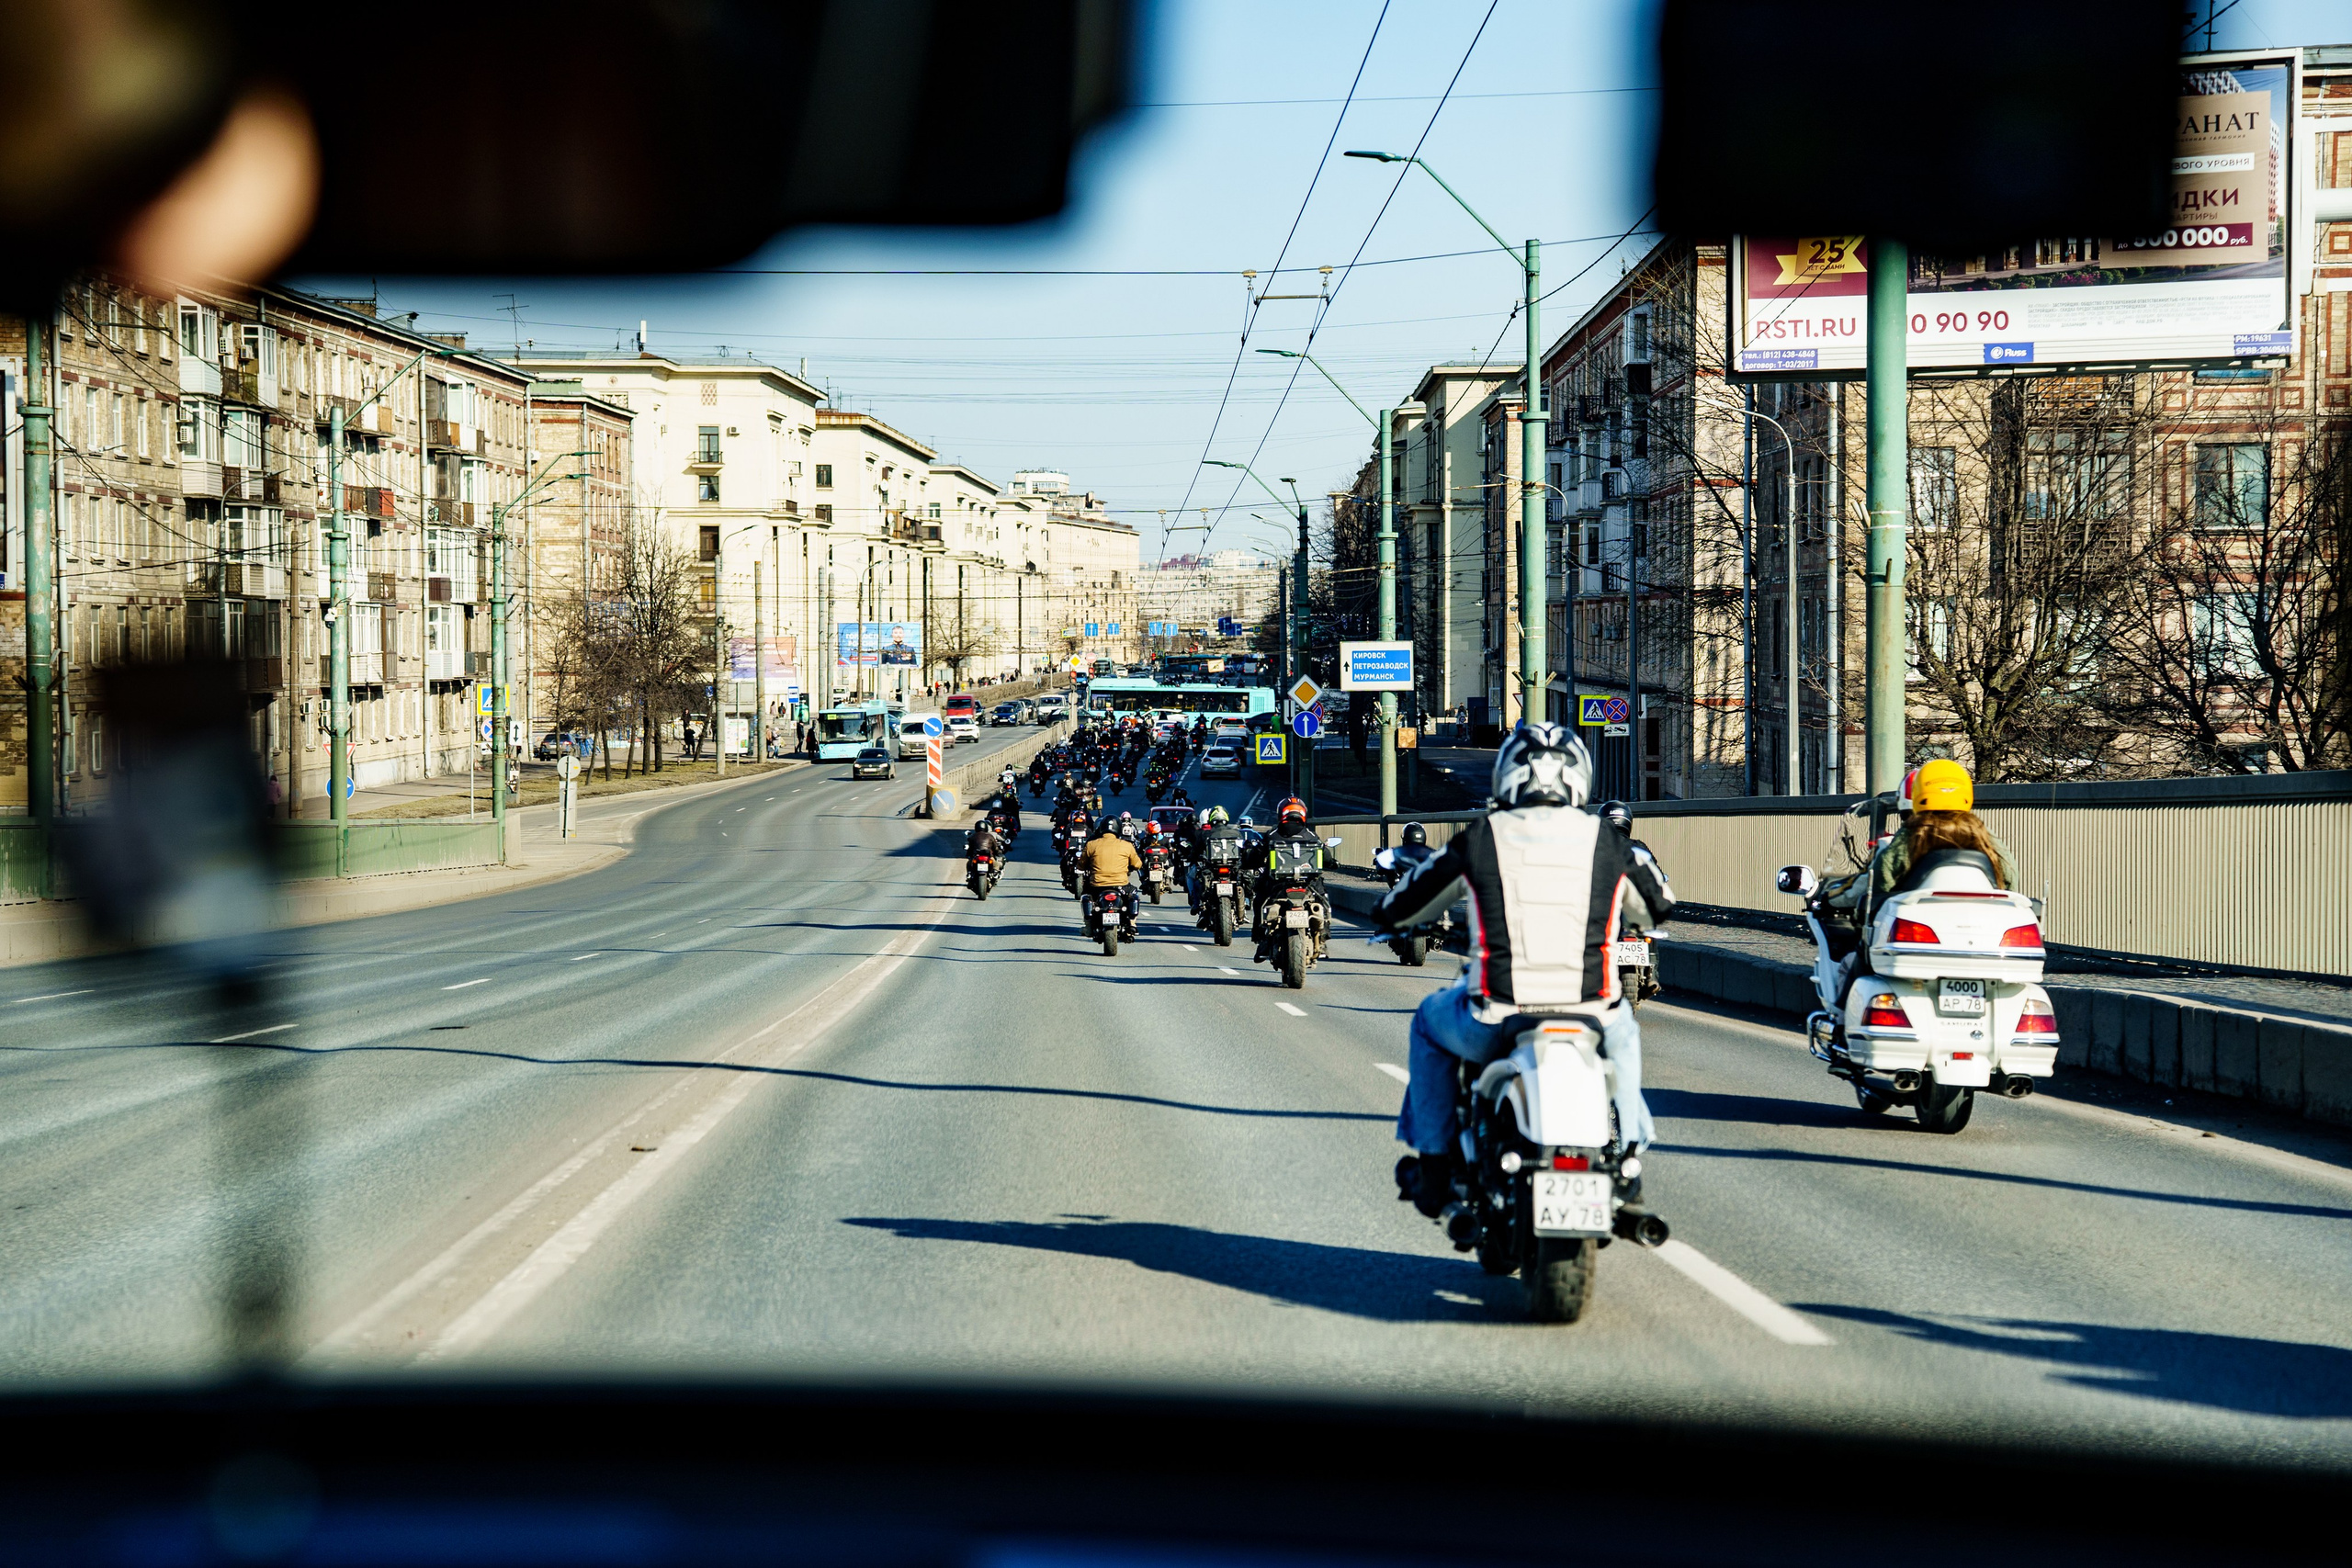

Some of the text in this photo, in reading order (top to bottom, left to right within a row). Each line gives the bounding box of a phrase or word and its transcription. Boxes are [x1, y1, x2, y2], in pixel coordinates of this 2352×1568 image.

[2206, 157, 2250, 168] УРОВНЯ
[2230, 235, 2249, 245] руб.
[1808, 240, 1845, 265] 25
[1936, 311, 1968, 333] 90
[1977, 310, 2009, 332] 90
[1756, 317, 1856, 340] RSTI.RU
[1763, 350, 1781, 359] (812)
[1782, 350, 1815, 359] 438-4848
[2004, 347, 2027, 357] Russ
[1619, 944, 1644, 953] 7405
[1617, 955, 1646, 964] АС 78
[1946, 981, 1978, 993] 4000
[1942, 998, 1982, 1010] АР 78
[1544, 1177, 1599, 1196] 2701
[1540, 1207, 1603, 1226] АУ 78
